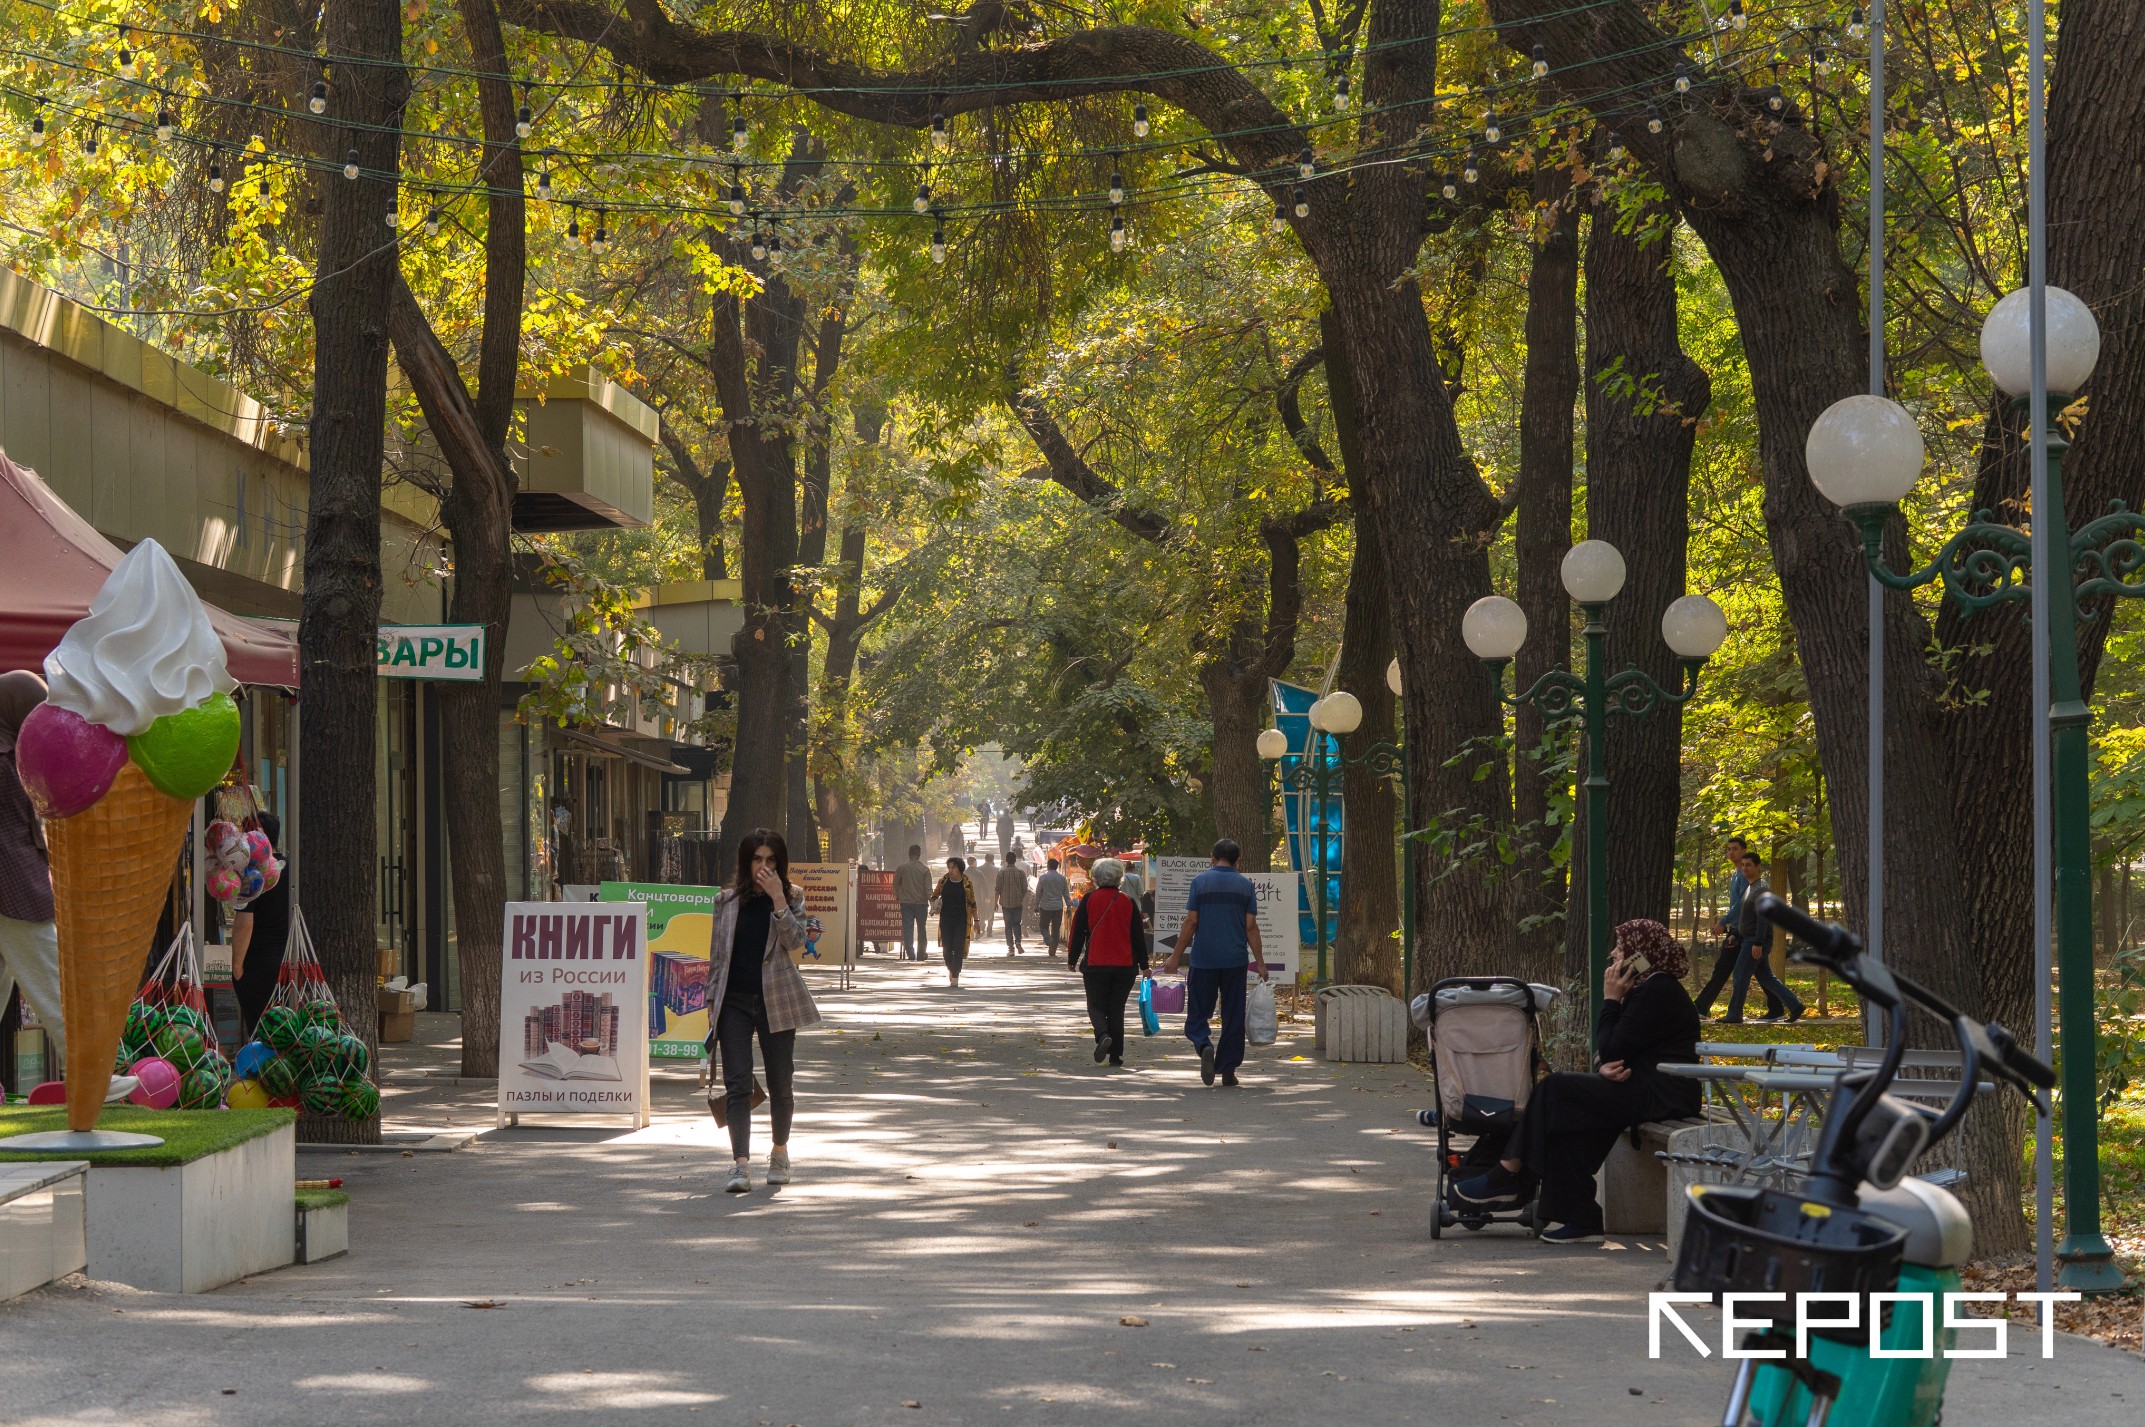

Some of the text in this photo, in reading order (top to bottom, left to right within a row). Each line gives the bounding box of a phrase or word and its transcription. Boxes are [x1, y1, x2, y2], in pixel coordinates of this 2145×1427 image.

[377, 636, 479, 669] ВАРЫ
[1161, 860, 1187, 868] BLACK
[861, 873, 881, 884] BOOK
[628, 888, 715, 906] Канцтовары
[512, 915, 637, 960] КНИГИ
[864, 929, 902, 937] ДОКУМЕНТОВ
[520, 967, 626, 984] из России
[506, 1090, 632, 1103] ПАЗЛЫ И ПОДЕЛКИ
